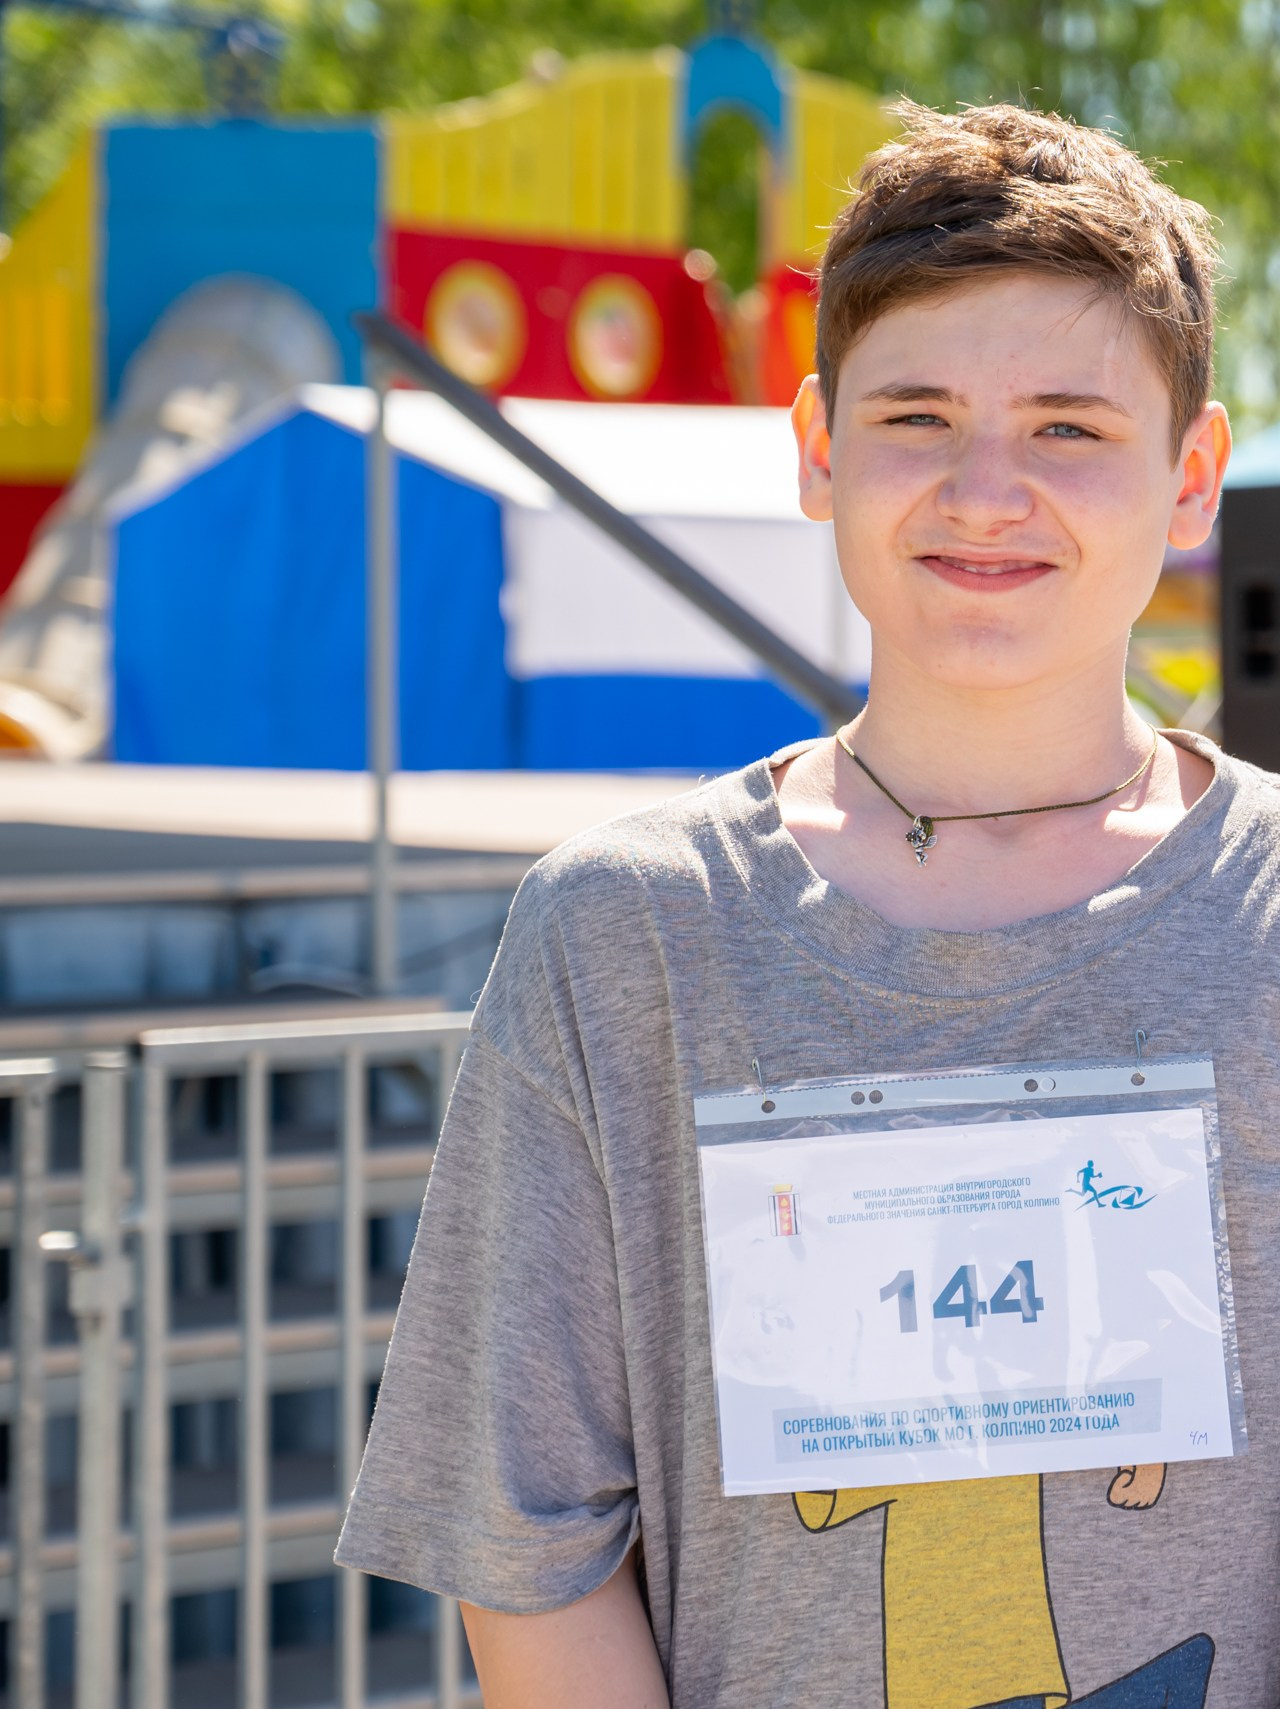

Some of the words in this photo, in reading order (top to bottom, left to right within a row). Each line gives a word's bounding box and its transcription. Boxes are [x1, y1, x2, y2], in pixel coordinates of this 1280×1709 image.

[853, 1189, 887, 1200] МЕСТНАЯ
[888, 1184, 954, 1198] АДМИНИСТРАЦИЯ
[956, 1177, 1031, 1191] ВНУТРИГОРОДСКОГО
[864, 1197, 936, 1210] МУНИЦИПАЛЬНОГО
[937, 1191, 990, 1204] ОБРАЗОВАНИЯ
[992, 1188, 1021, 1200] ГОРОДА
[827, 1210, 885, 1224] ФЕДЕРАЛЬНОГО
[886, 1207, 926, 1219] ЗНАЧЕНИЯ
[927, 1202, 997, 1217] САНКТ-ПЕТЕРБУРГА
[998, 1200, 1022, 1210] ГОРОД
[1024, 1197, 1060, 1208] КОЛПИНО
[880, 1260, 1044, 1333] 144
[783, 1412, 887, 1435] СОРЕВНОВАНИЯ
[891, 1410, 909, 1426] ПО
[913, 1402, 1009, 1423] СПОРТИВНОМУ
[1013, 1392, 1135, 1416] ОРИЕНТИРОВАНИЮ
[802, 1438, 820, 1453] НА
[823, 1428, 895, 1451] ОТКРЫТЫЙ
[899, 1428, 940, 1447] КУБОК
[945, 1425, 965, 1442] МО
[982, 1419, 1046, 1438] КОЛПИНО
[1049, 1416, 1082, 1433] 2024
[1085, 1413, 1120, 1431] ГОДА
